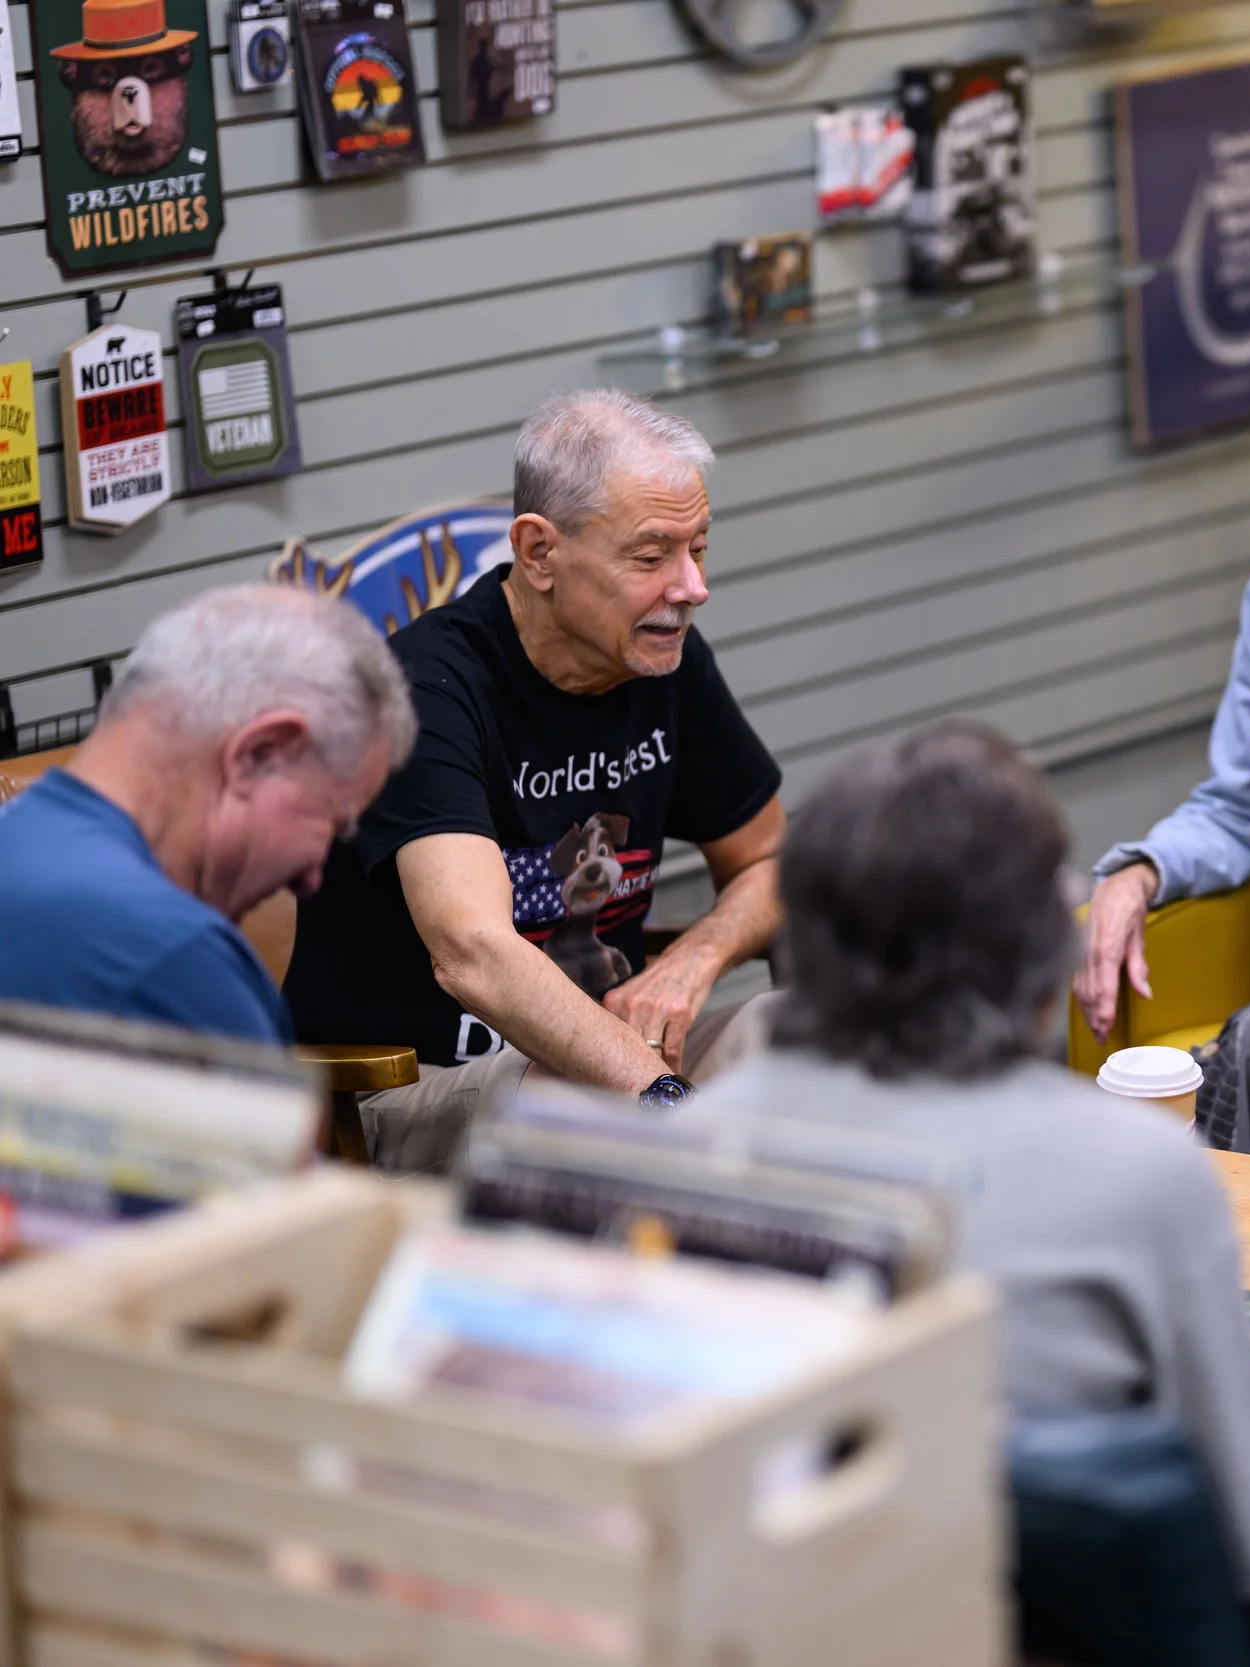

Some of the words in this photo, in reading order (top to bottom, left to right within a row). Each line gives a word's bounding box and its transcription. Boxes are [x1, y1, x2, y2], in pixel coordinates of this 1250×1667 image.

[67, 172, 206, 213] PREVENT
[69, 196, 209, 251] WILDFIRES
[81, 352, 156, 391] NOTICE
[84, 386, 158, 429] BEWARE
[88, 448, 126, 466] THEY
[131, 439, 160, 457] ARE
[206, 413, 274, 455] VETERAN
[88, 452, 161, 483] STRICTLY
[2, 511, 38, 556] ME
[624, 728, 671, 783] est
